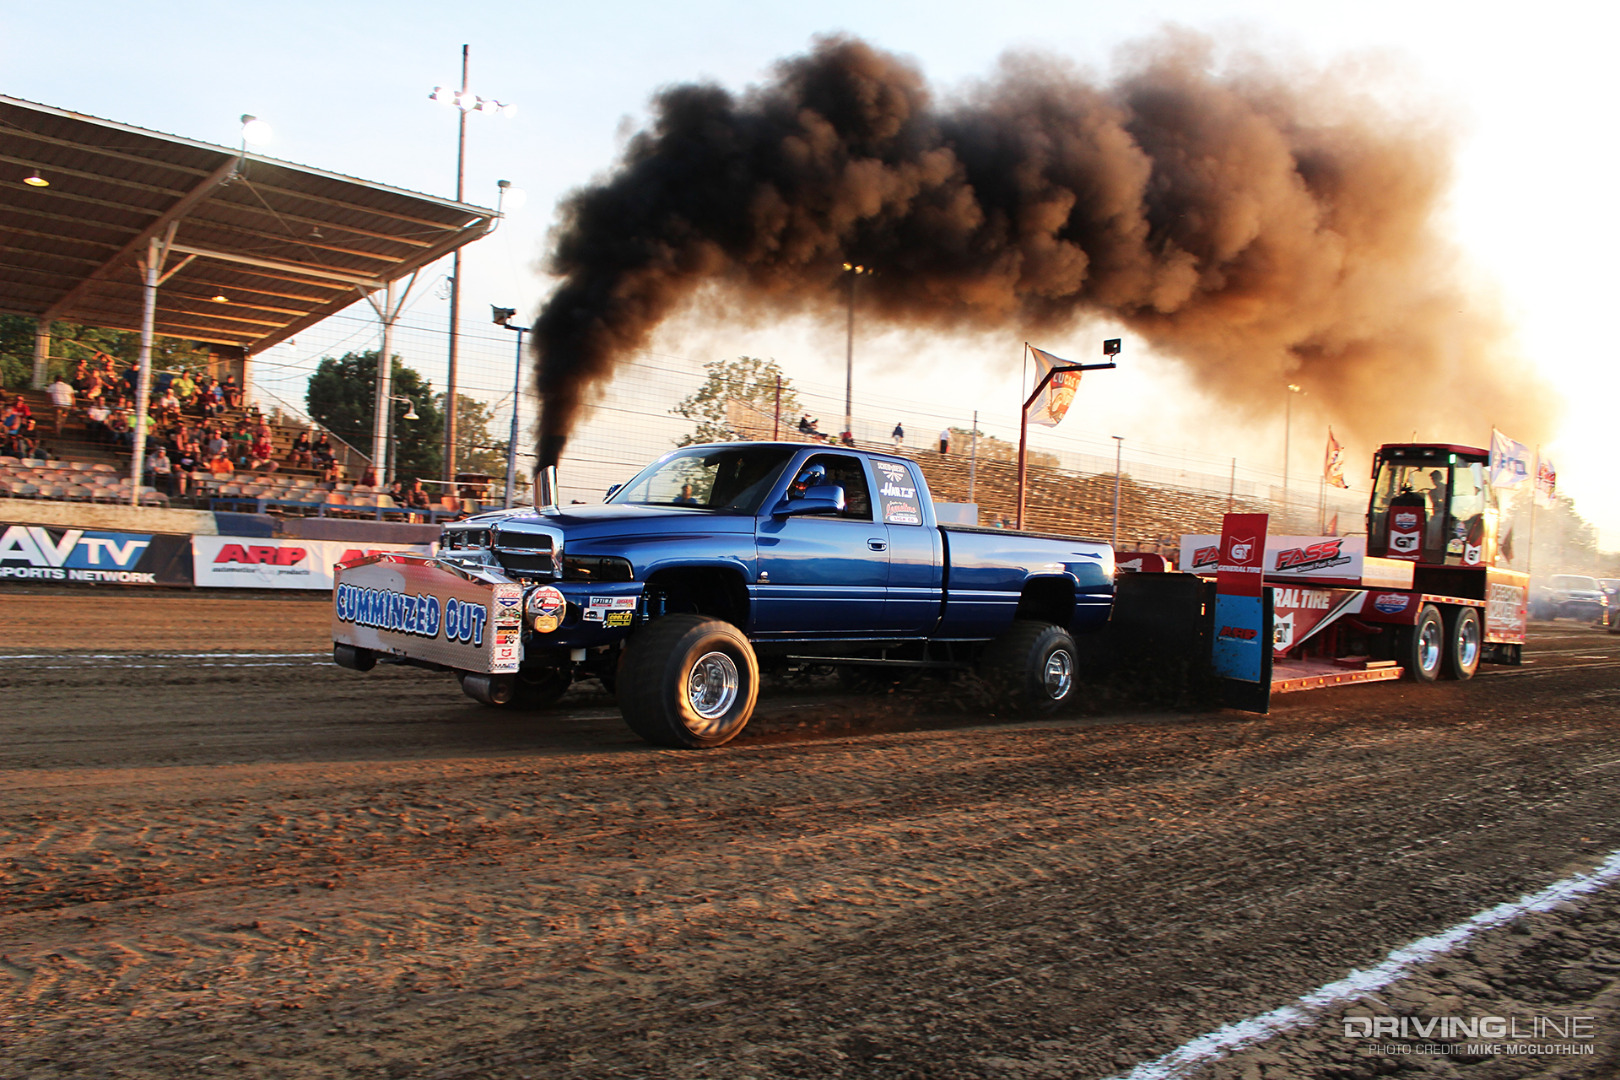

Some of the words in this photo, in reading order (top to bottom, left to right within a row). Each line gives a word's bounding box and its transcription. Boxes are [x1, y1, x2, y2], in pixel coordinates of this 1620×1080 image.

[213, 543, 307, 567] ARP
[1192, 545, 1221, 568] FA
[1231, 544, 1252, 560] GT
[1275, 539, 1343, 571] FASS
[68, 569, 157, 583] NETWORK
[1218, 565, 1246, 573] GENERAL
[1246, 566, 1262, 574] TIRE
[1300, 589, 1331, 609] TIRE
[336, 583, 441, 637] CUMMINZED
[445, 597, 487, 645] OUT
[1219, 625, 1258, 640] ARP
